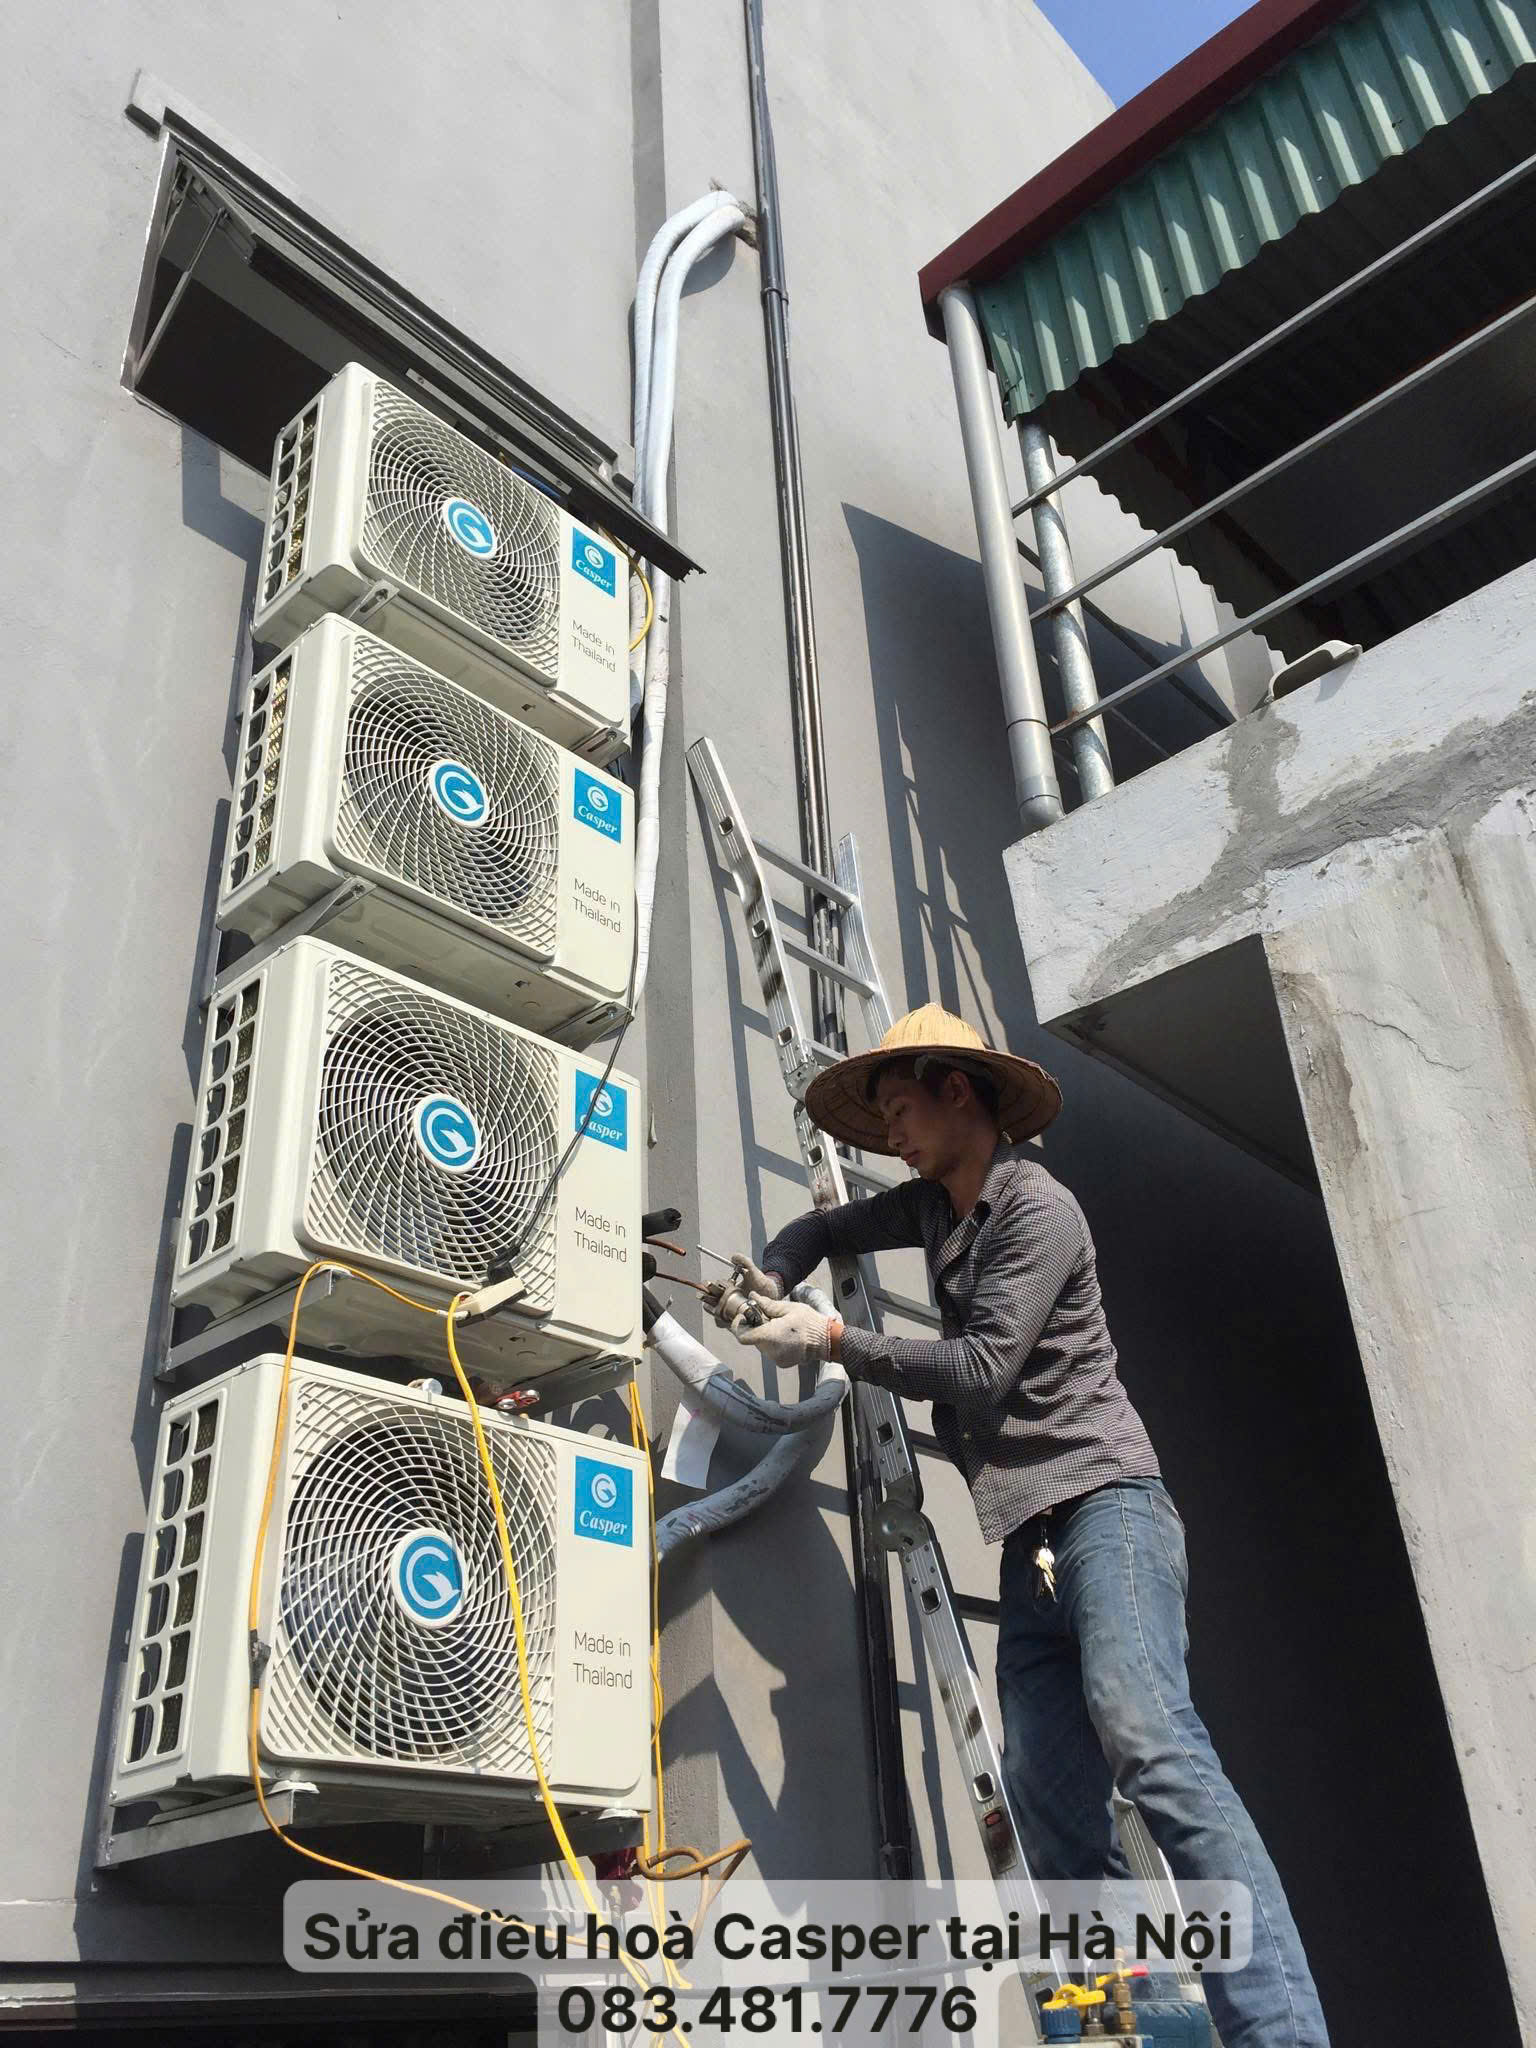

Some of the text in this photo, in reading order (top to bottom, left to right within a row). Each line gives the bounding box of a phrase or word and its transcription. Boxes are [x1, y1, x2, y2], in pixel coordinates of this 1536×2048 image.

[575, 559, 612, 588] Casper
[572, 619, 615, 655] Made in
[571, 635, 616, 673] Thailand
[577, 805, 618, 834] Casper
[574, 878, 621, 913] Made in
[572, 896, 622, 933] Thailand
[575, 1206, 626, 1238] Made in
[573, 1230, 627, 1263] Thailand
[579, 1510, 628, 1536] Casper
[574, 1630, 631, 1657] Made in
[573, 1662, 633, 1689] Thailand
